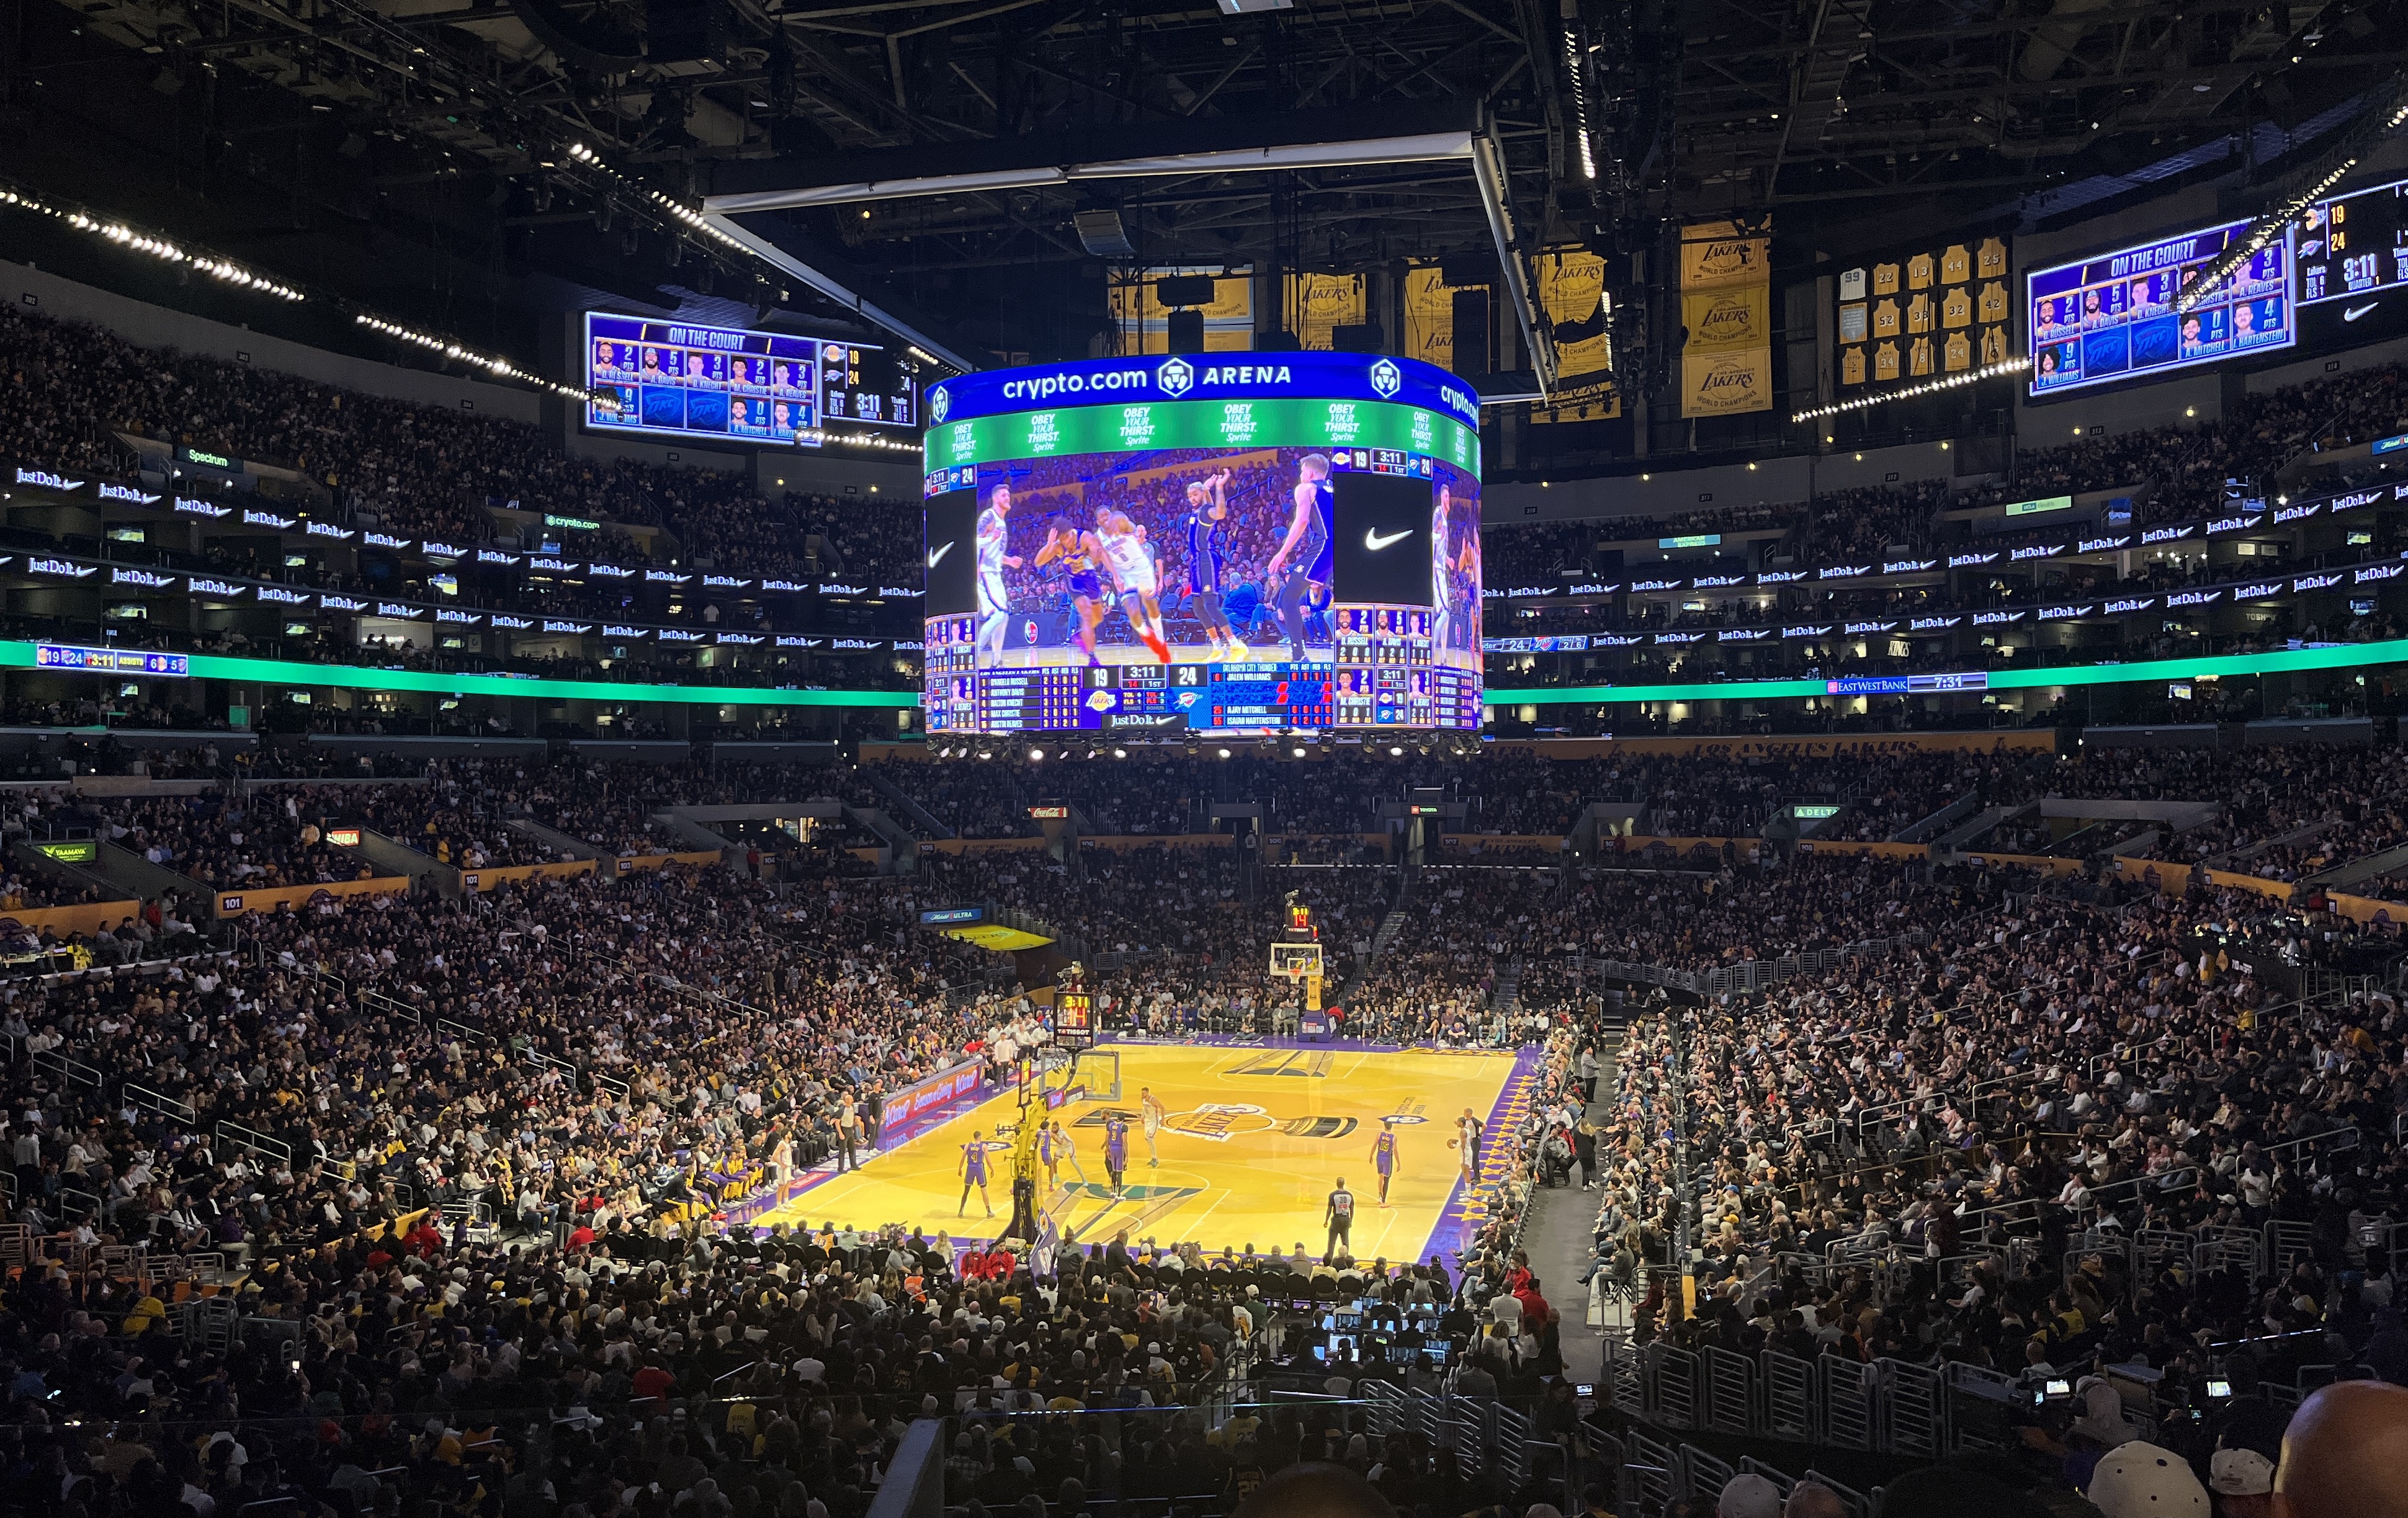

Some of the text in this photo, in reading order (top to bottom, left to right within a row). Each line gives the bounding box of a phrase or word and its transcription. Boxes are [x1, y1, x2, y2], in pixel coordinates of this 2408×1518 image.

[2331, 205, 2344, 225] 19
[2331, 231, 2345, 251] 24
[1984, 254, 2000, 266] 25
[2111, 239, 2198, 277] ON THE COURT
[2264, 249, 2273, 267] 3
[1913, 267, 1928, 277] 13
[1948, 261, 1963, 272] 44
[2343, 253, 2376, 282] 3:11
[1552, 265, 1602, 282] LAKERS
[1879, 272, 1892, 283] 22
[2262, 267, 2275, 279] PTS
[2248, 280, 2274, 295] REAVES
[2348, 277, 2372, 290] QUARTER
[2112, 285, 2119, 301] 5
[1985, 299, 2000, 309] 42
[2110, 302, 2122, 313] PTS
[2265, 300, 2275, 317] 4
[1949, 305, 1964, 316] 32
[1702, 310, 1750, 327] LAKERS
[1880, 316, 1893, 326] 52
[2099, 315, 2118, 328] DAVIS
[2213, 311, 2221, 328] 0
[669, 327, 745, 350] ON THE COURT
[1698, 326, 1752, 341] WORLD CHAMPIONS
[2239, 329, 2284, 348] HARTENSTEIN
[1951, 348, 1964, 359] 24
[2066, 343, 2074, 359] 9
[2193, 341, 2225, 357] MITCHELL
[669, 352, 677, 366] 5
[714, 356, 721, 370] 3
[849, 350, 859, 364] 19
[1881, 358, 1893, 368] 34
[668, 367, 679, 375] PTS
[712, 370, 723, 379] PTS
[659, 375, 676, 386] DAVIS
[849, 370, 859, 385] 24
[1003, 366, 1291, 400] crypto.com ARENA
[1701, 373, 1755, 391] LAKERS
[2048, 371, 2079, 385] WILLIAMS
[857, 393, 880, 413] 3:11
[1696, 390, 1757, 407] WORLD CHAMPIONS
[1224, 404, 1252, 414] OBEY
[1031, 414, 1055, 425] OBEY
[1225, 413, 1251, 423] YOUR
[1413, 411, 1430, 423] OBEY
[1032, 424, 1055, 434] YOUR
[1227, 432, 1251, 444] Sprite
[1033, 442, 1055, 453] Sprite
[1415, 440, 1430, 450] Sprite
[189, 449, 228, 467] Spectrum
[1354, 451, 1430, 474] 19 3:11 24
[555, 517, 599, 529] crypto.com
[1510, 640, 1524, 651] 24
[1887, 640, 1911, 657] KINGS
[48, 651, 177, 669] 19 24 3:11 ASSISTS 6 5
[1093, 666, 1196, 687] 19 3:11 24
[1384, 670, 1400, 679] 3:11
[1935, 676, 1963, 689] 7:31
[1111, 715, 1129, 727] Just
[1130, 715, 1145, 725] Do
[1395, 710, 1404, 720] 24
[467, 876, 477, 884] 102
[225, 898, 240, 908] 101
[1294, 915, 1307, 927] 14
[1065, 996, 1088, 1007] 3:11
[1068, 1007, 1085, 1027] 14
[1041, 1137, 1045, 1146] 2
[1381, 1141, 1389, 1151] 15
[970, 1152, 978, 1163] 4
